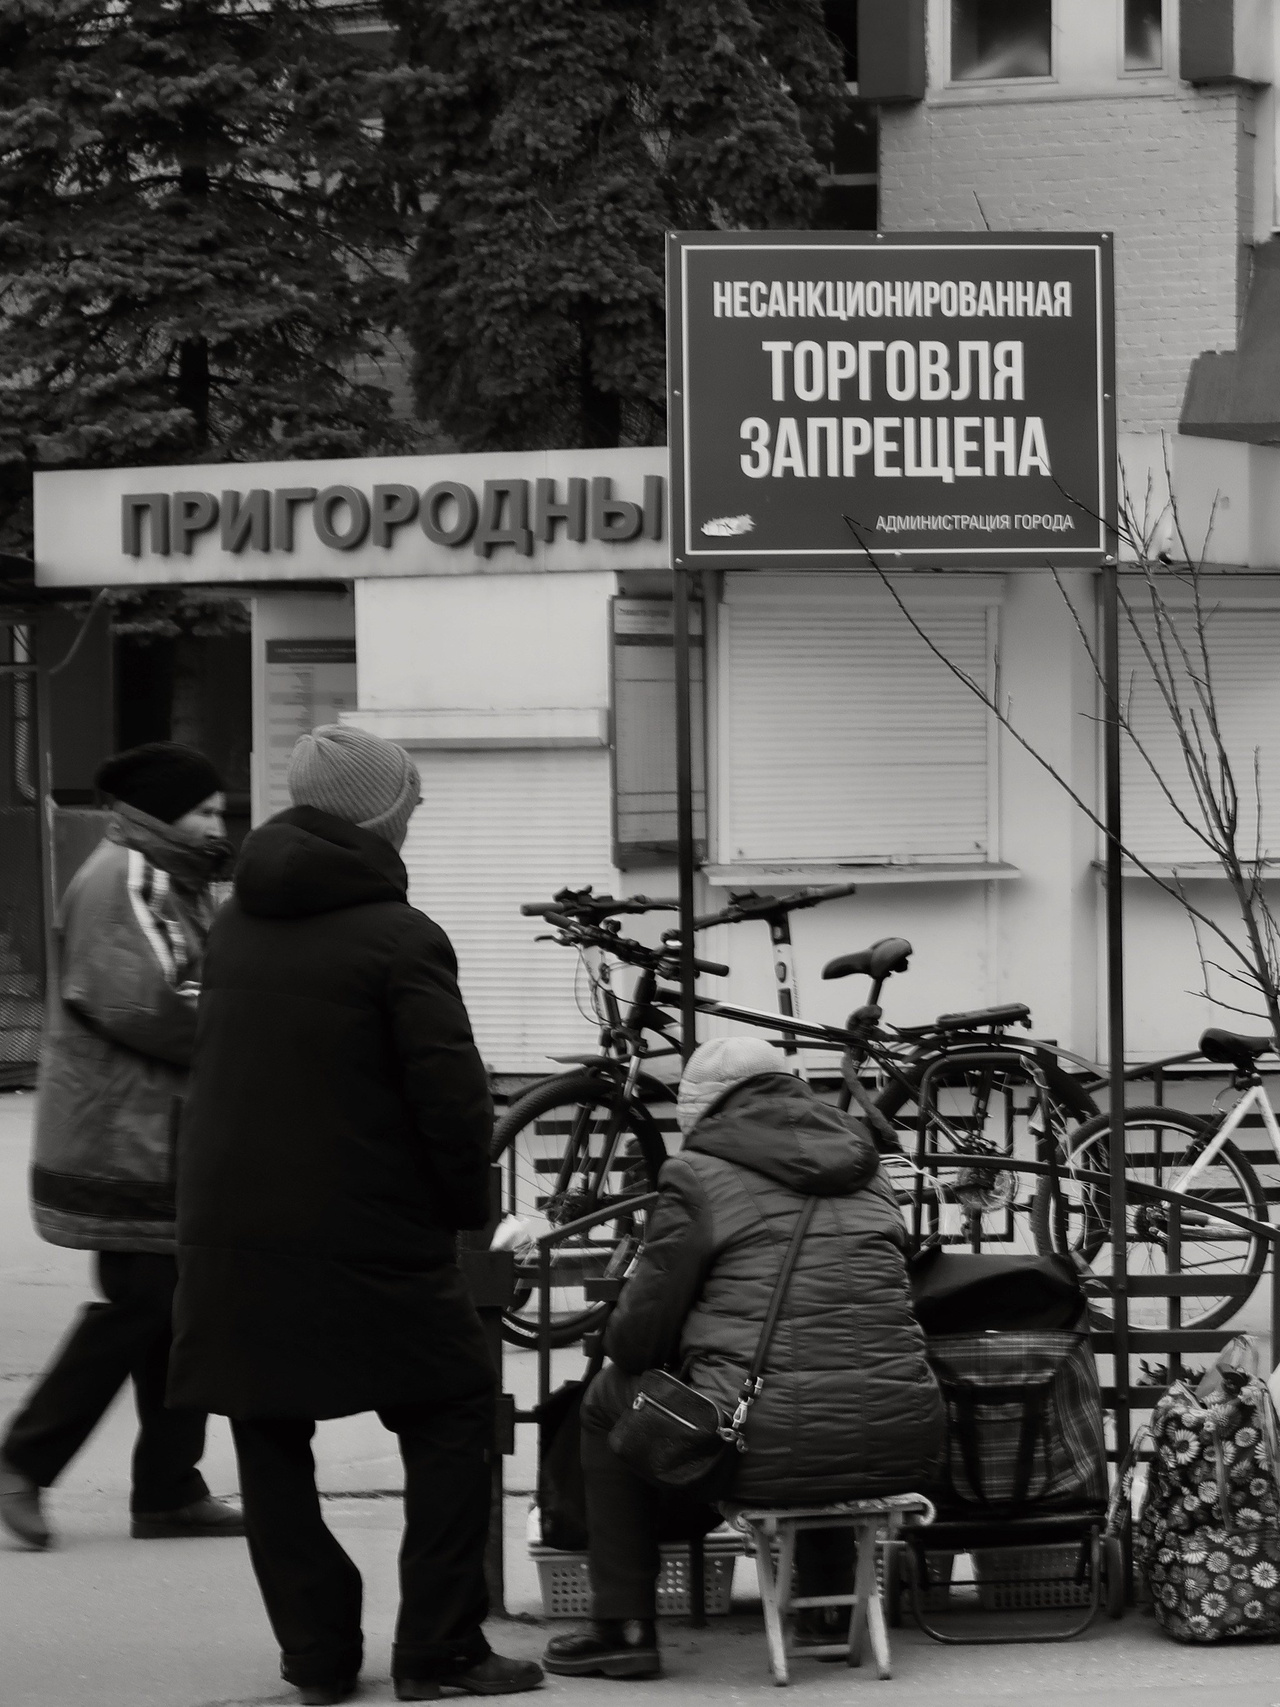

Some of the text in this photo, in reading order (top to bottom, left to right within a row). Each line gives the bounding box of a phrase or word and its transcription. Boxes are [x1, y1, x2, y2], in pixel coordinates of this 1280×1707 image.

[713, 281, 1071, 319] НЕСАНКЦИОНИРОВАННАЯ
[762, 340, 1024, 400] ТОРГОВЛЯ
[740, 417, 1052, 482] ЗАПРЕЩЕНА
[876, 514, 1075, 533] АДМИНИСТРАЦИЯ ГОРОДА
